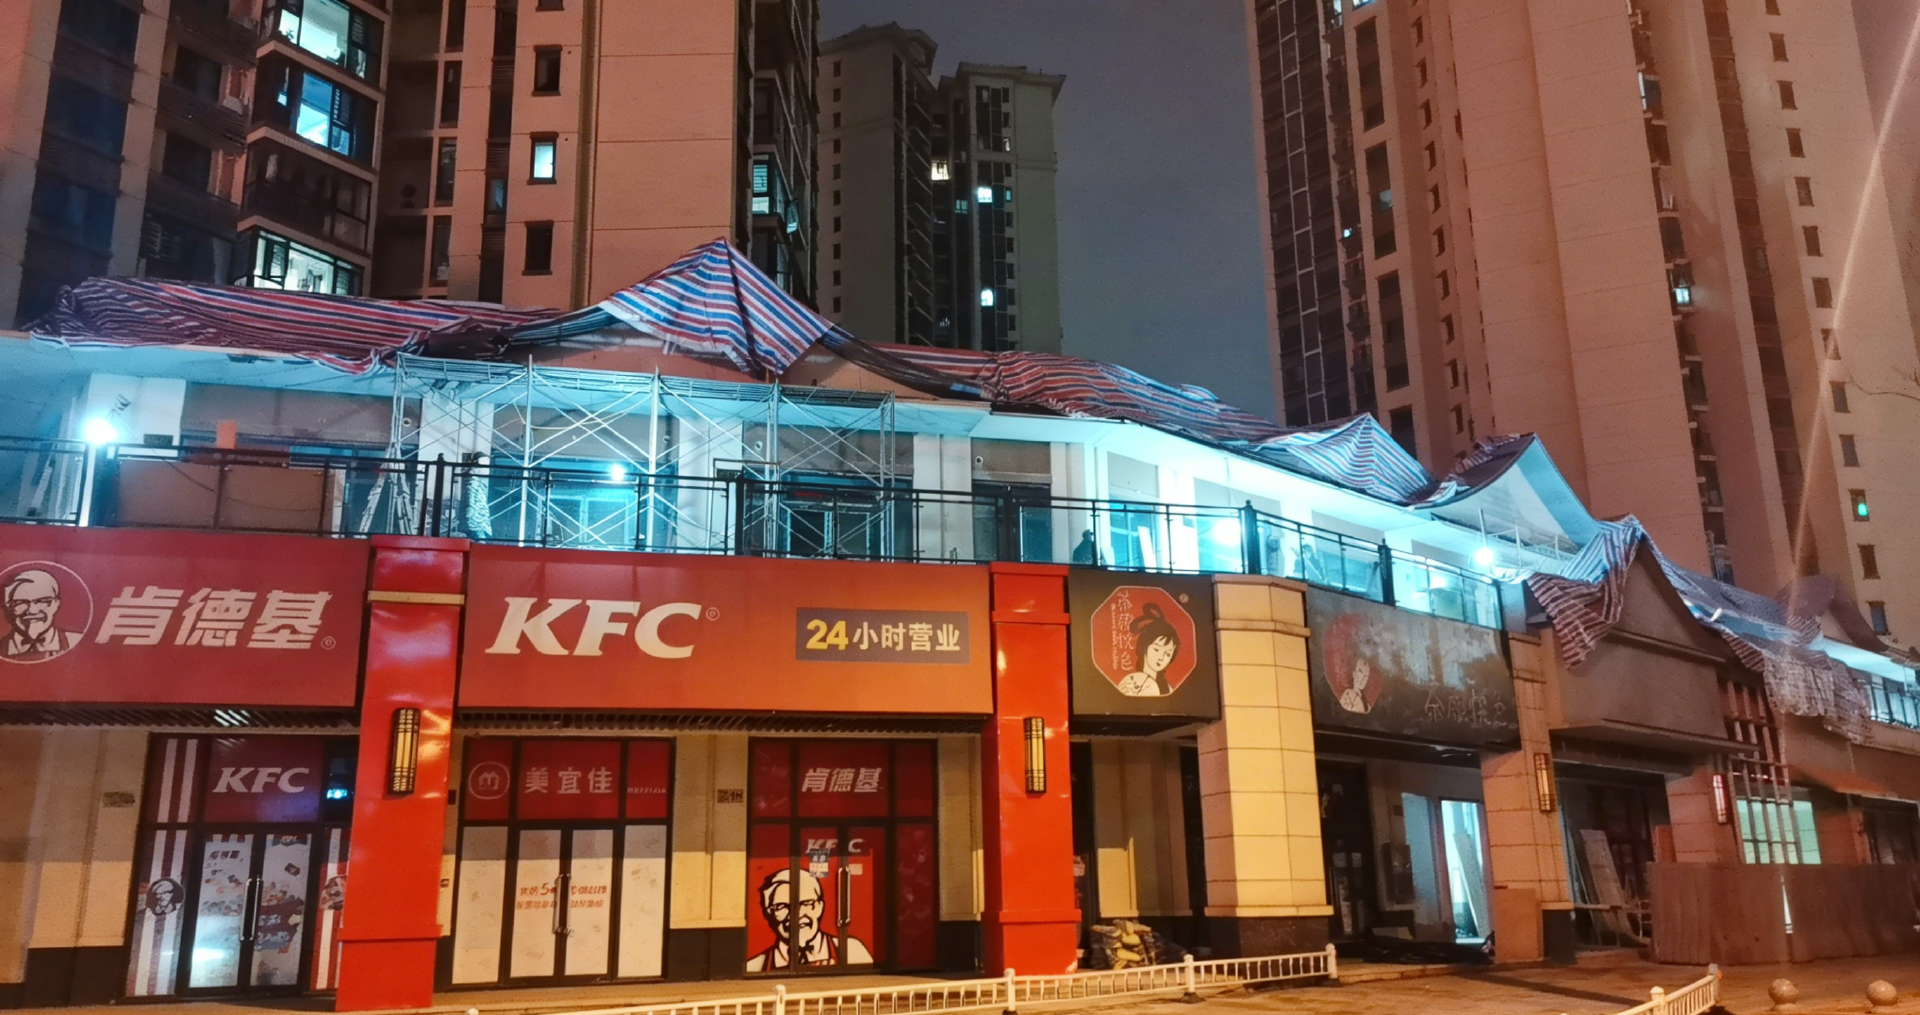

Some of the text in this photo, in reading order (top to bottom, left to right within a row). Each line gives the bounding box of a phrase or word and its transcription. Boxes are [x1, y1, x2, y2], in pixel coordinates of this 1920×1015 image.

[94, 586, 332, 650] 肯德基
[484, 597, 703, 659] KFC
[805, 618, 961, 652] 24小时营业
[211, 766, 310, 794] KFC
[524, 766, 613, 794] 美宜佳
[801, 767, 882, 793] 肯德基
[805, 838, 863, 854] KFC
